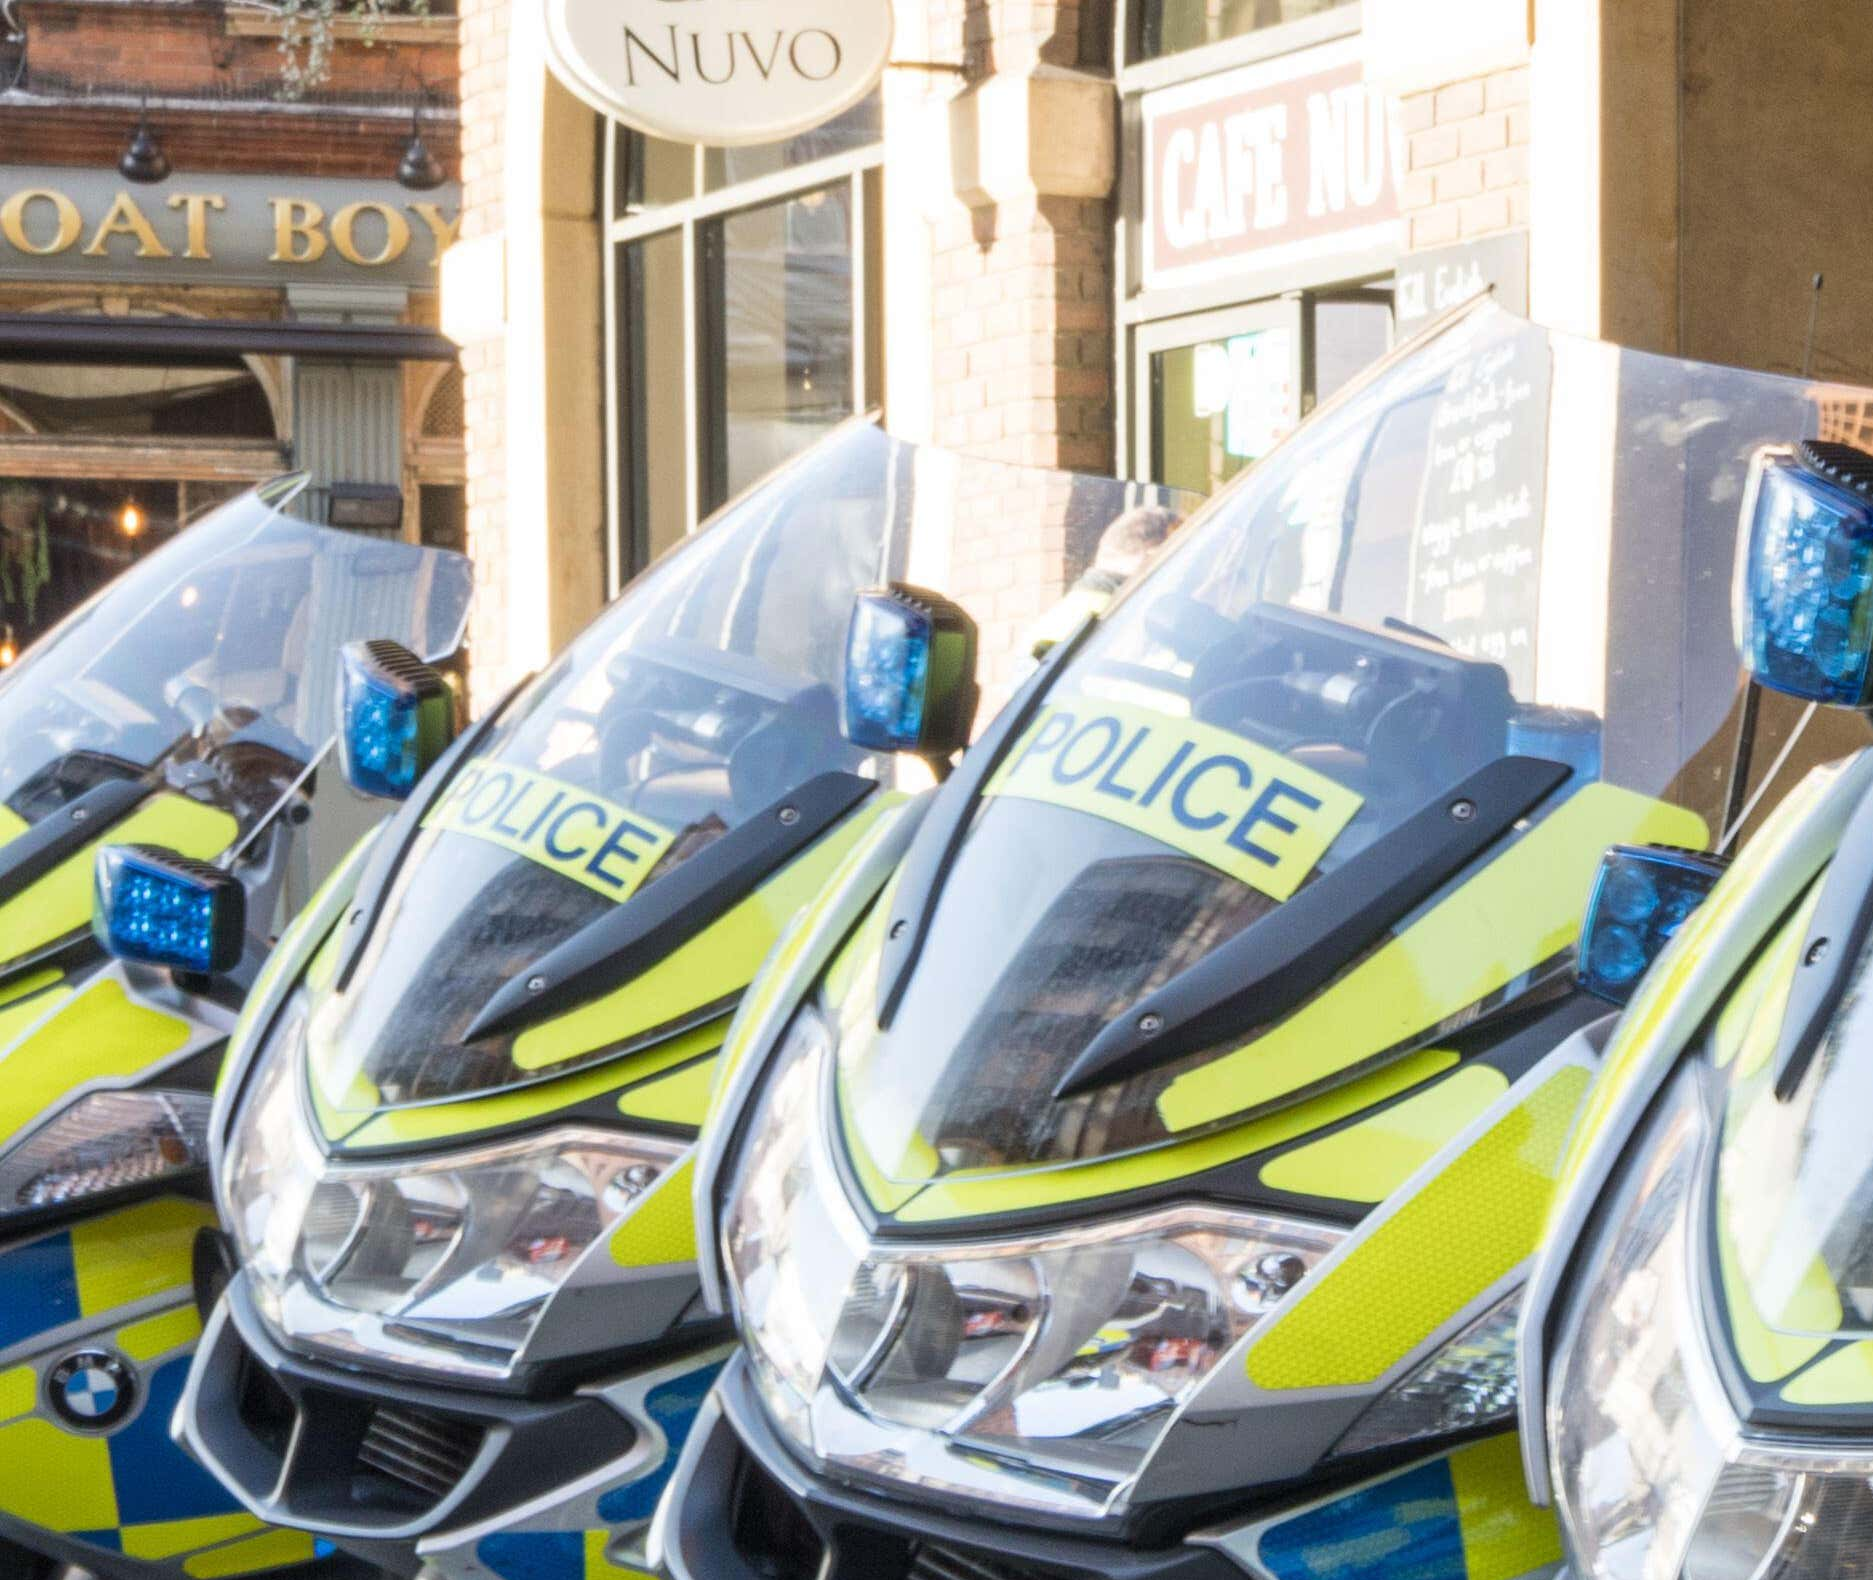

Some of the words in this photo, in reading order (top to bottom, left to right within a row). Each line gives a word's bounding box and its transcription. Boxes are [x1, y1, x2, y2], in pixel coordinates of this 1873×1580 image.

[623, 24, 842, 86] NUVO
[0, 187, 227, 260] OAT
[268, 196, 463, 267] BOY
[1162, 102, 1287, 249] CAFE
[436, 768, 659, 890] POLICE
[1007, 711, 1323, 869] POLICE
